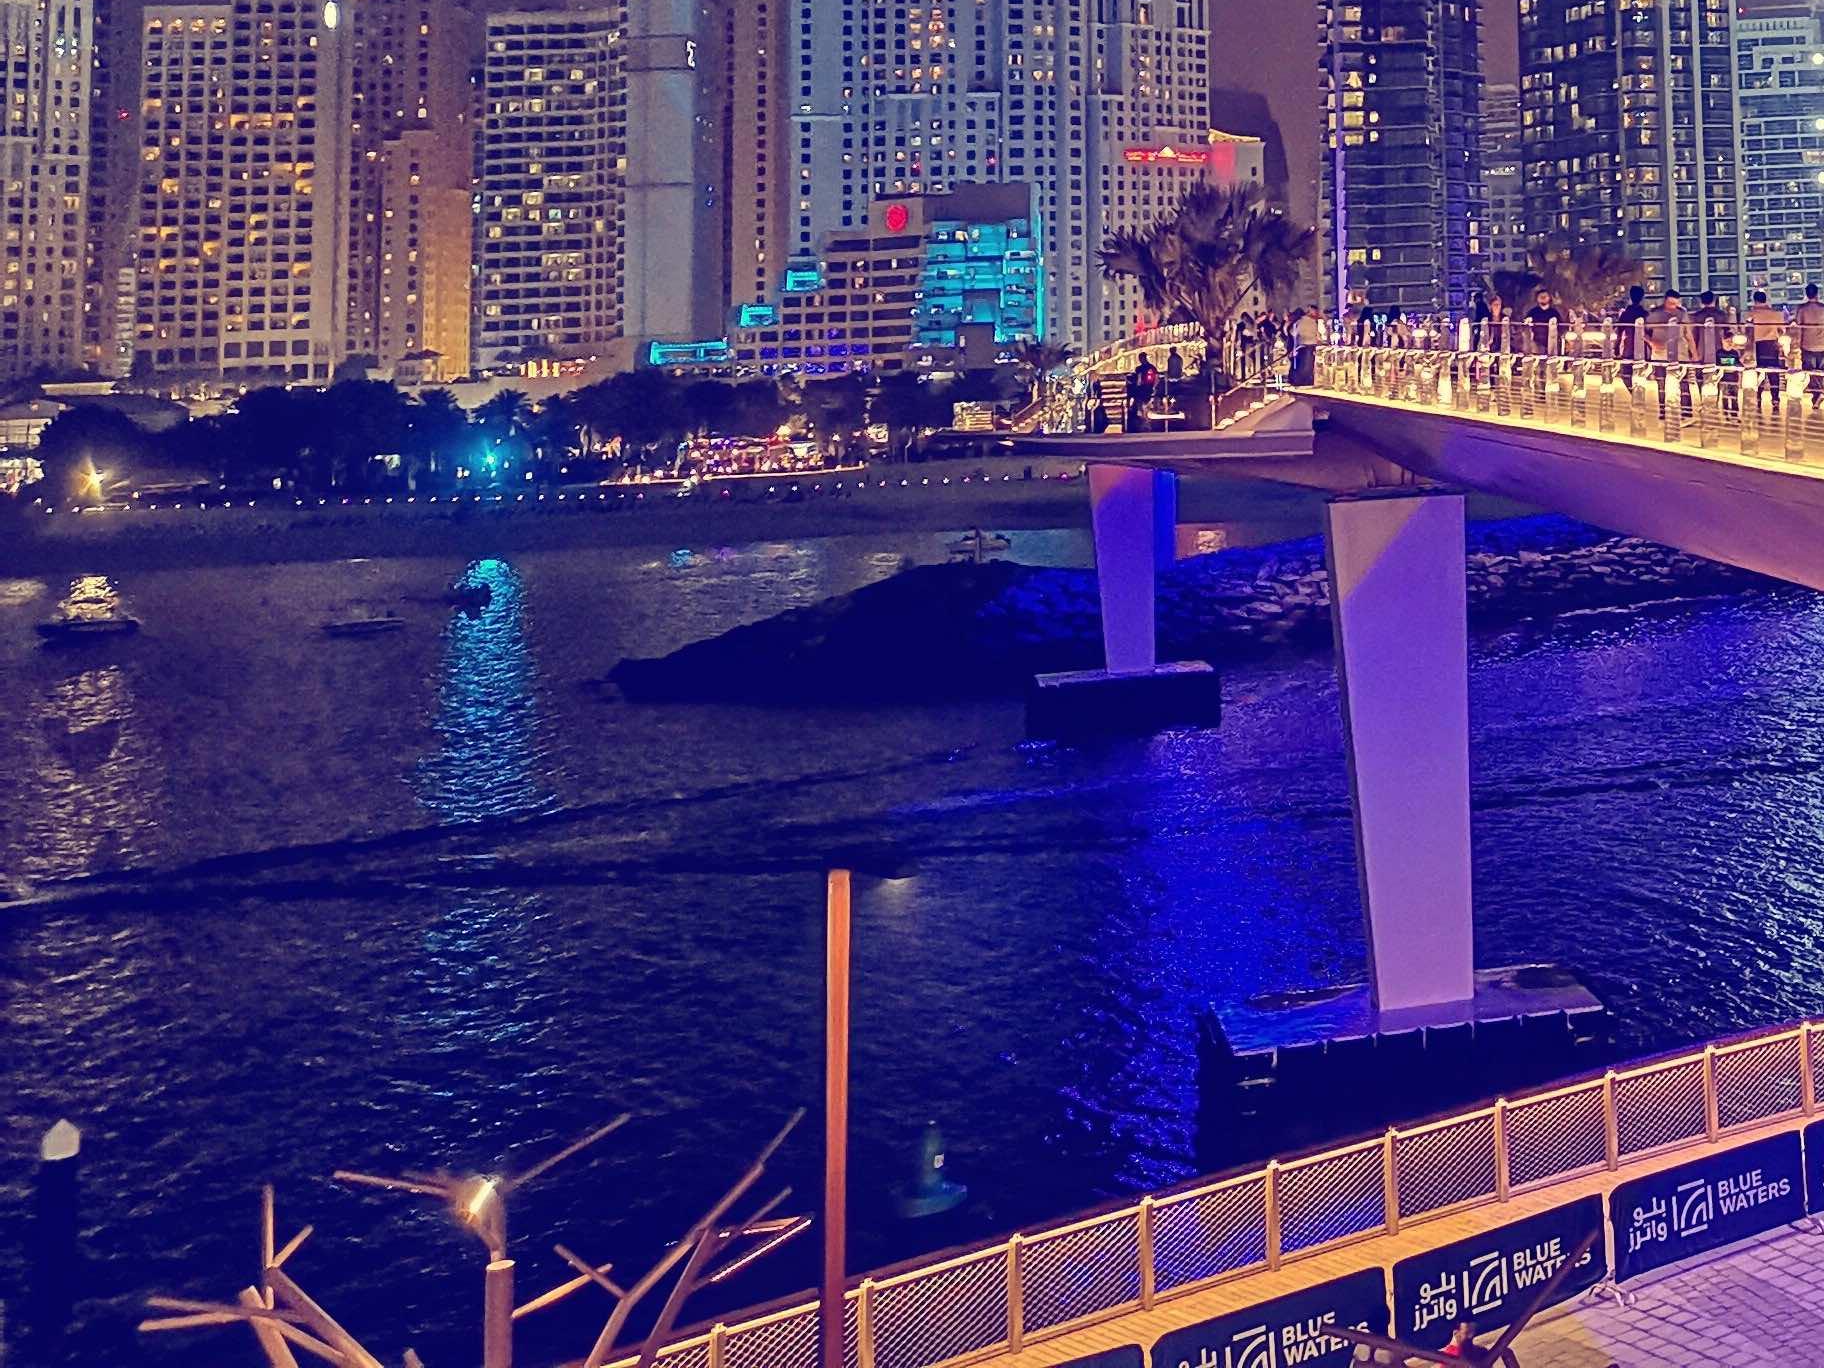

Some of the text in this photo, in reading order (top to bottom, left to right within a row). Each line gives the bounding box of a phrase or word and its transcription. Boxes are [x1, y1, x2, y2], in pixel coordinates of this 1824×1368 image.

[1717, 1169, 1762, 1199] BLUE
[1719, 1178, 1791, 1216] WATERS
[1632, 1196, 1667, 1227] بلو
[1628, 1219, 1668, 1253] واترز
[1513, 1237, 1561, 1271] BLUE
[1419, 1271, 1456, 1304] بلو
[1413, 1297, 1457, 1332] واترز
